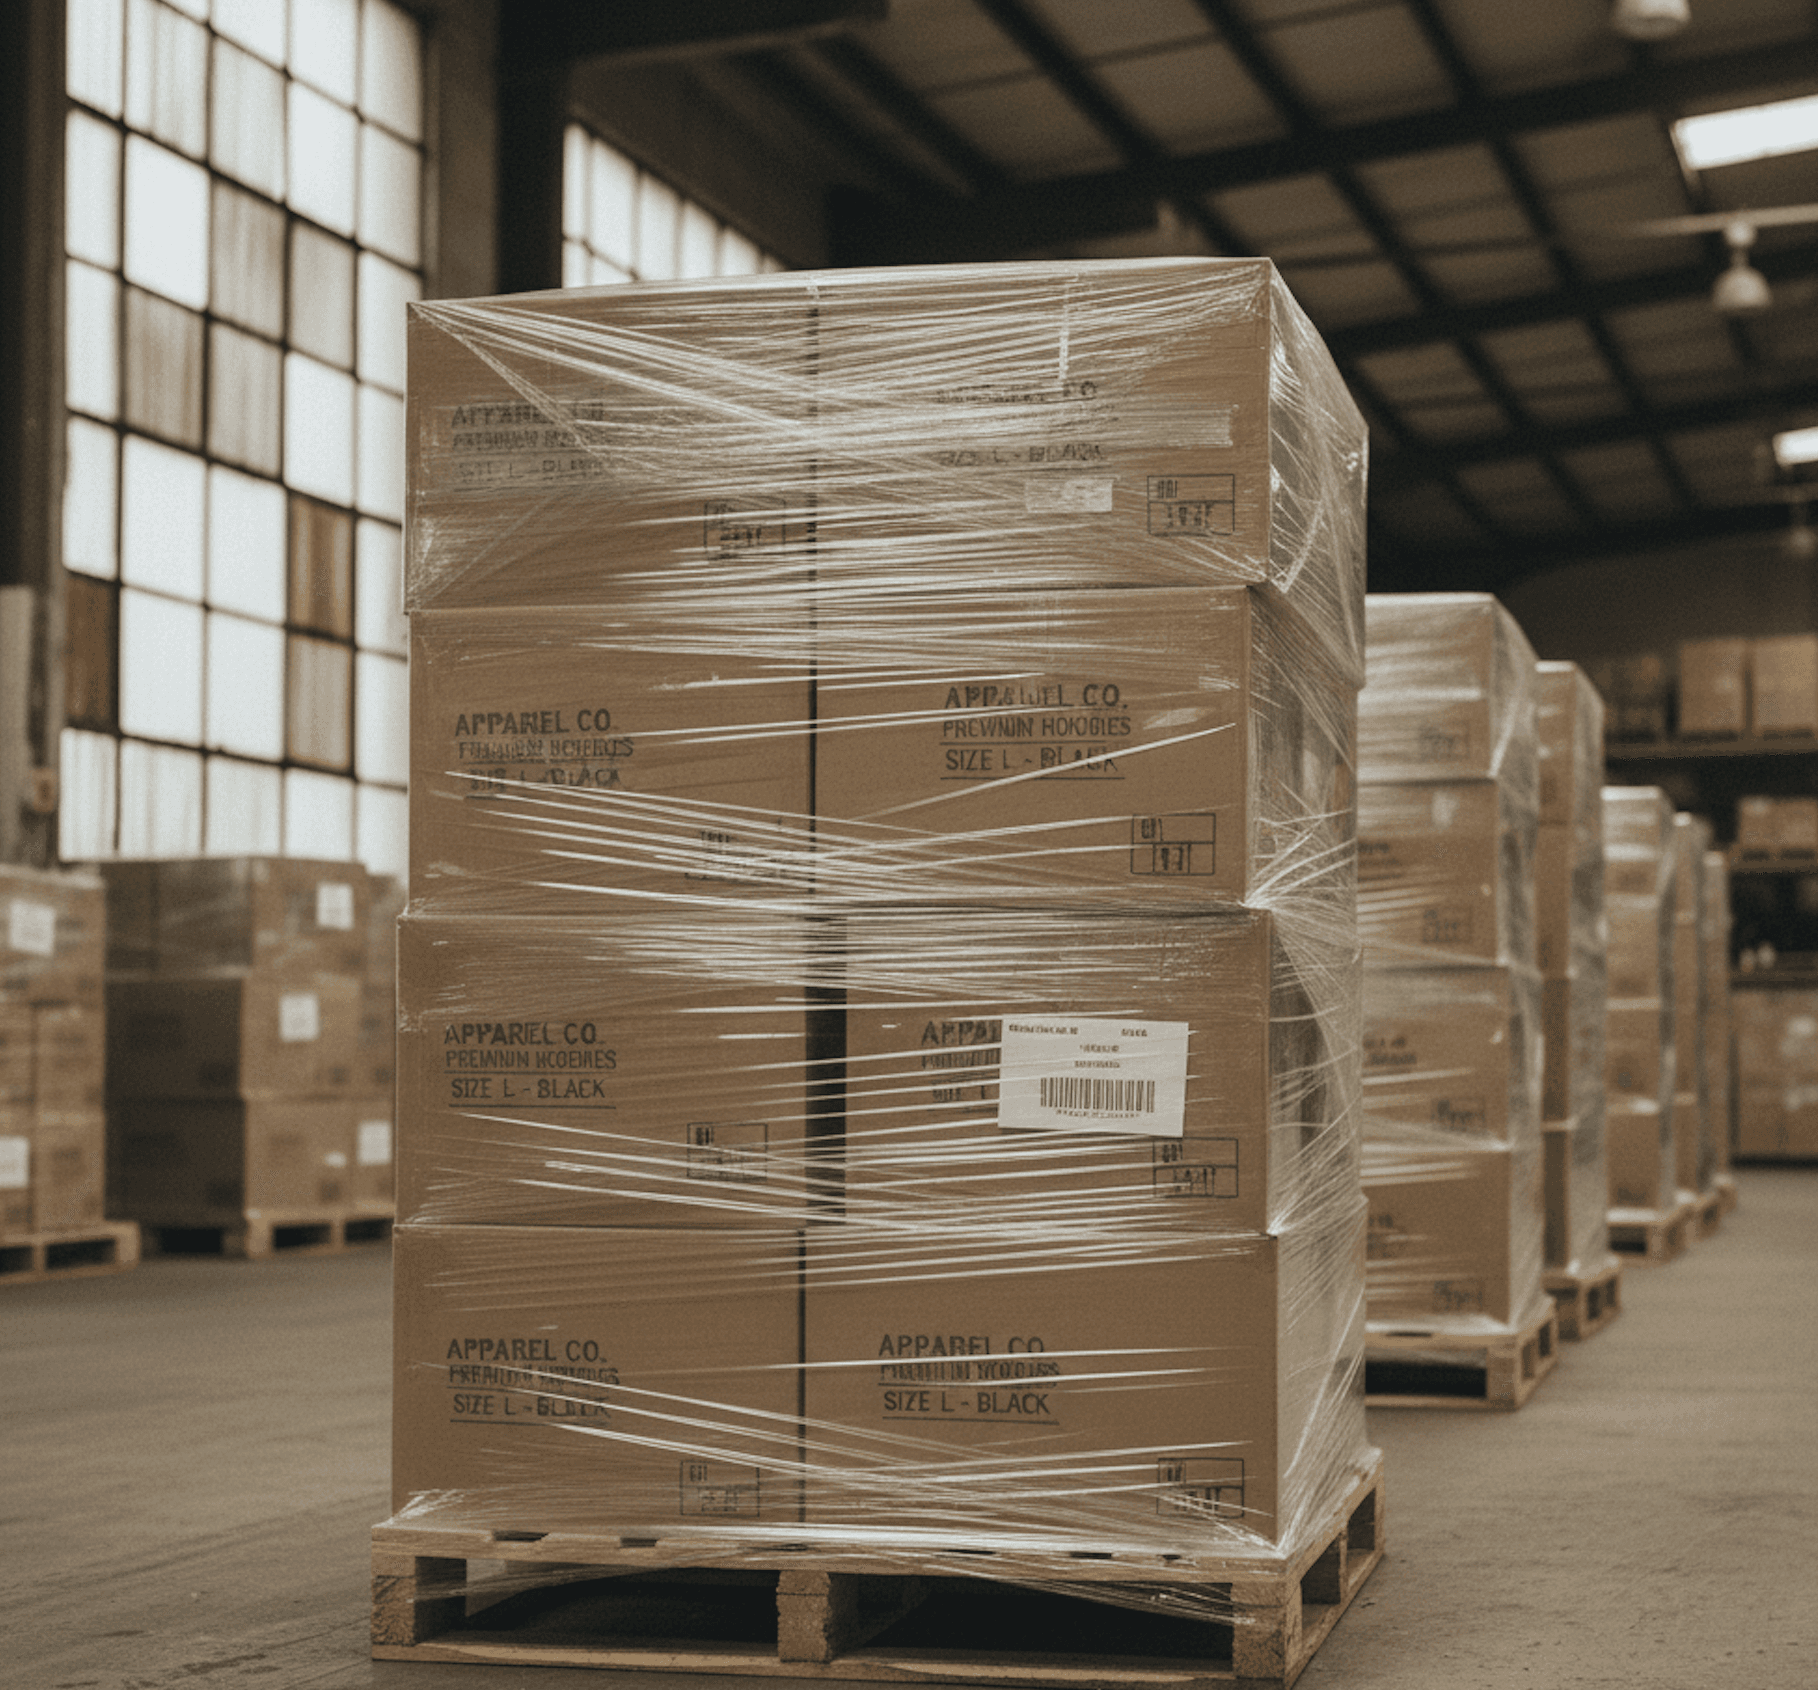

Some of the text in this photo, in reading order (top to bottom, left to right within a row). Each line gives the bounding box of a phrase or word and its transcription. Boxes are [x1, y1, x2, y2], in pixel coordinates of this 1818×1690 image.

[1083, 684, 1128, 709] CO.
[945, 749, 993, 771] SIZE
[1003, 749, 1011, 769] L
[451, 1077, 493, 1099] SIZE
[503, 1078, 516, 1098] L
[537, 1078, 606, 1099] BLACK
[446, 1338, 607, 1363] APPAREL CO.
[453, 1393, 494, 1416] SIZE
[504, 1396, 516, 1416] L
[884, 1390, 930, 1412] SIZE
[941, 1391, 955, 1412] L
[977, 1391, 1050, 1415] BLACK
